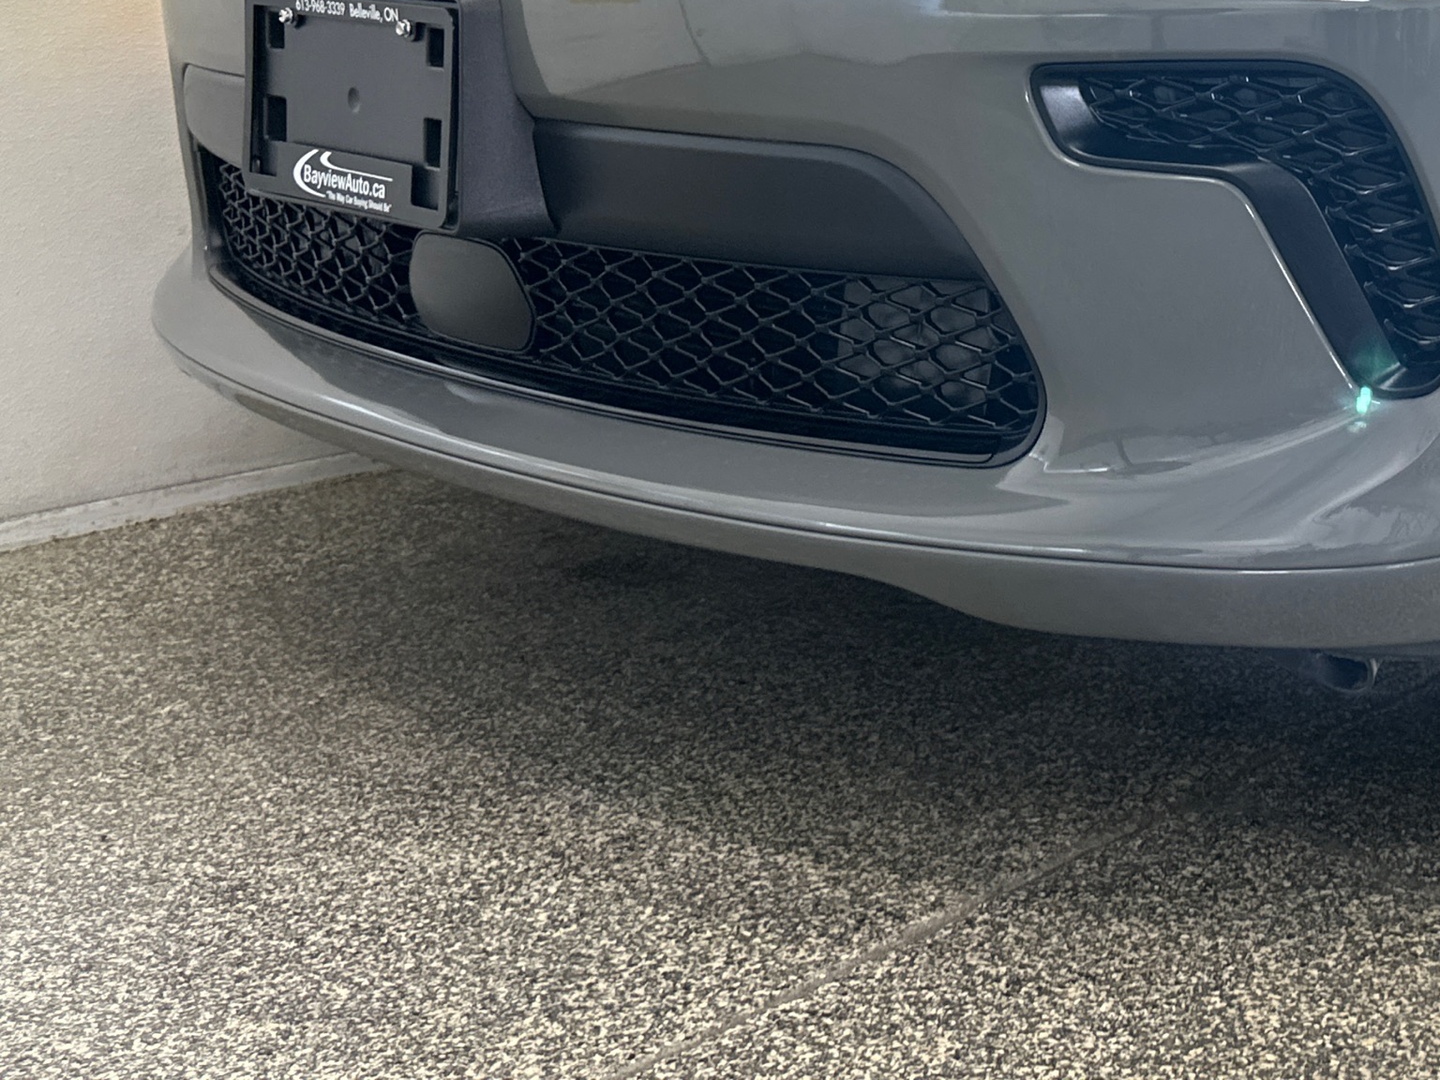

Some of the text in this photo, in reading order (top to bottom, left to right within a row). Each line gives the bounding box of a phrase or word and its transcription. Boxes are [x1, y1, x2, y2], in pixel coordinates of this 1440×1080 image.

[349, 2, 383, 23] Belleville,
[384, 6, 399, 22] ON
[303, 164, 385, 199] BayviewAuto.ca
